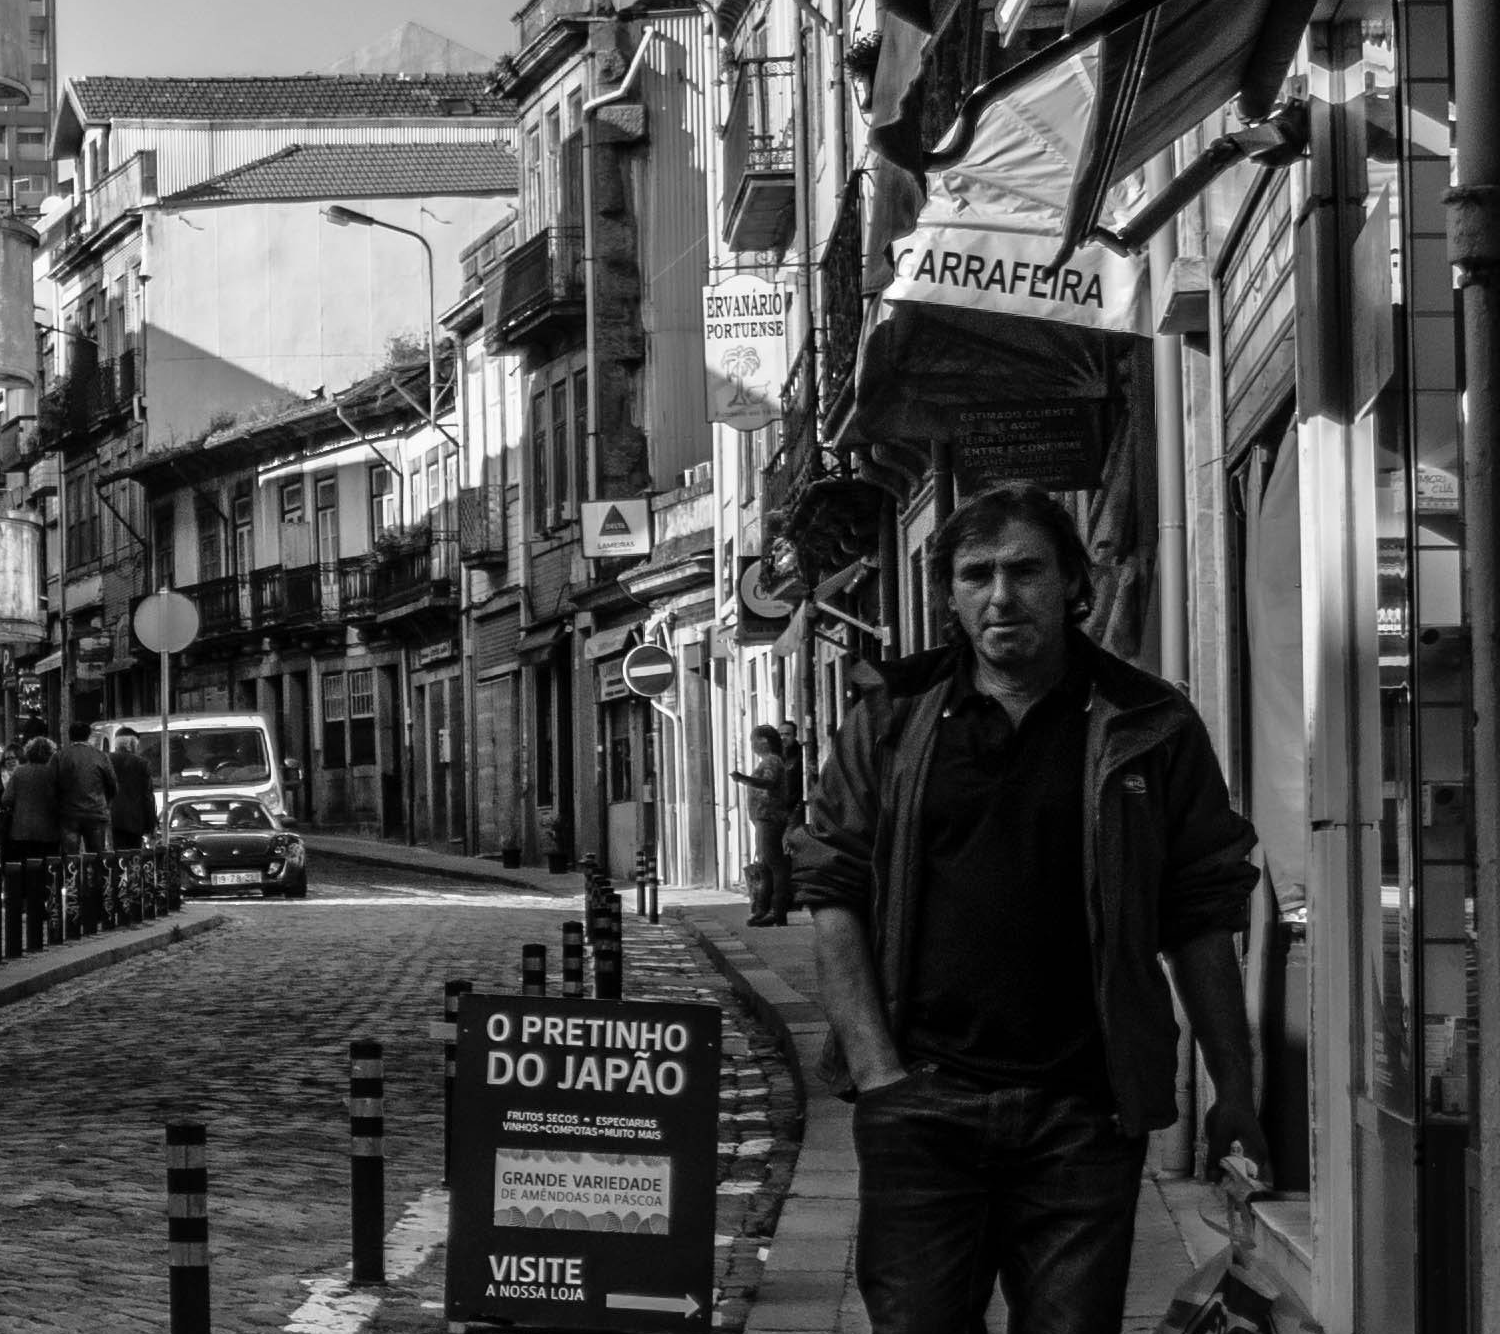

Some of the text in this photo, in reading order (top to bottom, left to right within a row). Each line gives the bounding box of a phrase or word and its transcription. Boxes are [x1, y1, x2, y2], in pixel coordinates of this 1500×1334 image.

[706, 288, 783, 319] ERVANÁRIO
[706, 320, 784, 340] PORTUENSE
[486, 1013, 689, 1054] O PRETINHO
[486, 1050, 685, 1096] DO JAPÃO
[506, 1110, 658, 1129] FRUTOS SECOS ESPECIARIAS
[638, 1129, 662, 1140] MAIS
[502, 1170, 663, 1192] GRANDE VARIEDADE
[500, 1186, 663, 1208] DE AMÊNDOAS DA PÁSCOA
[488, 1254, 584, 1286] VISITE
[484, 1284, 586, 1302] A NOSSA LOJA
